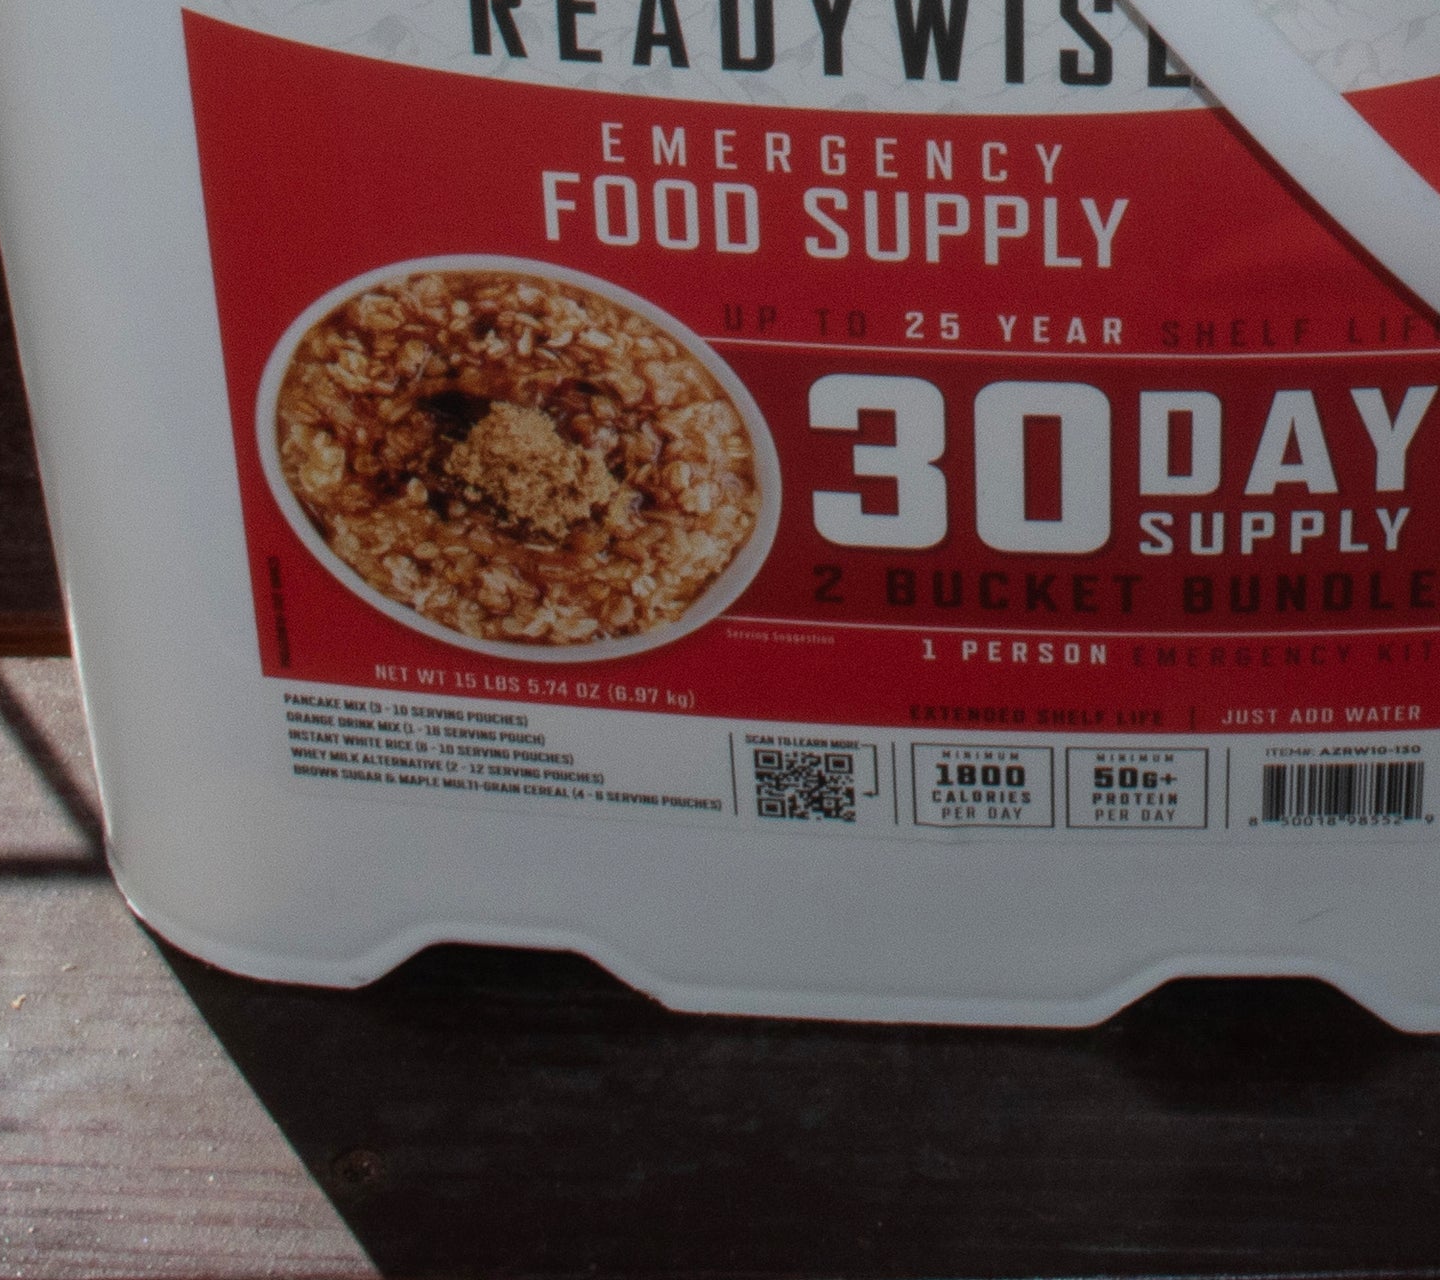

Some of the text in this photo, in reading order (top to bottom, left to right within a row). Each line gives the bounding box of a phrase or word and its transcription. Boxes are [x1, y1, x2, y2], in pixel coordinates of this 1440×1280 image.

[601, 121, 1063, 183] EMERGENCY
[542, 170, 1129, 268] FOOD SUPPLY
[722, 303, 776, 333] UP
[814, 308, 866, 338] TO
[904, 311, 960, 340] 25
[996, 314, 1123, 345] YEAR
[1160, 318, 1310, 348] SHELF
[808, 372, 1438, 555] 30 DAY
[1139, 507, 1410, 556] SUPPLY
[812, 563, 1438, 615] 2 BUCKET BUNDLE
[922, 639, 1433, 667] 1 PERSON EMERGENCY KIT
[374, 664, 697, 709] NET WT 15 LBS 5.74 OZ (6.97 kg)
[284, 692, 341, 709] PANCAKE
[344, 699, 368, 713] MIX
[411, 705, 464, 721] SERVING
[467, 710, 528, 727] POUCHES)
[286, 710, 334, 727] ORANGE
[338, 716, 375, 730] DRINK
[378, 720, 401, 733] MIX
[443, 726, 497, 741] SERVING
[910, 704, 1164, 726] EXTENDED SHELF LIFE
[1221, 704, 1423, 725] JUST ADD WATER
[288, 728, 340, 744] INSTANT
[342, 734, 383, 749] WHITE
[385, 738, 411, 751] RICE
[456, 744, 510, 759] SERVING
[513, 748, 574, 766] POUCHES)
[290, 746, 327, 760] WHEY
[330, 750, 359, 763] MILK
[362, 754, 442, 771] ALTERNATIVE
[488, 763, 541, 779] SERVING
[544, 768, 604, 785] POUCHES)
[936, 762, 1027, 787] 1800
[293, 763, 338, 778] BROWN
[341, 768, 382, 782] SUGAR
[399, 773, 440, 788] MAPLE
[523, 784, 569, 799] CEREAL
[606, 790, 659, 806] SERVING
[662, 794, 722, 811] POUCHES)
[931, 790, 1031, 804] CALORIES
[1092, 792, 1178, 806] PROTEIN
[941, 806, 1023, 821] PER DAY
[1095, 809, 1177, 822] PER DAY
